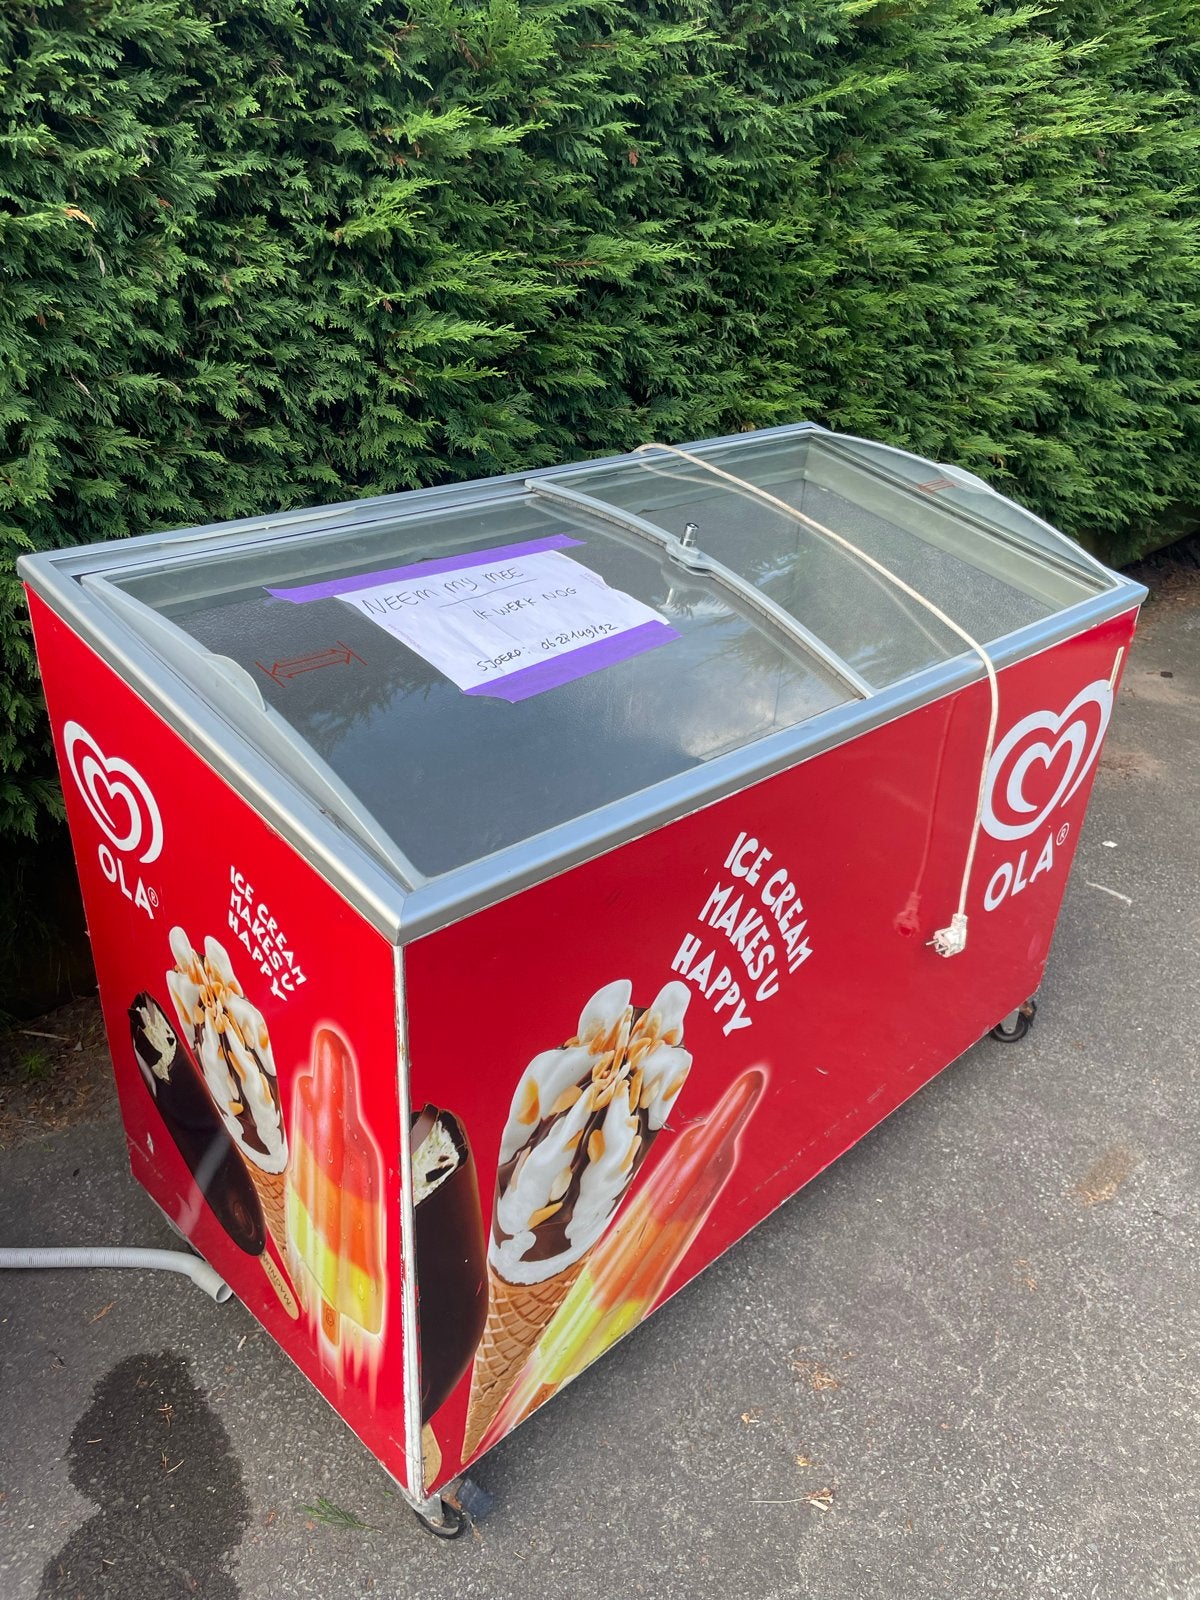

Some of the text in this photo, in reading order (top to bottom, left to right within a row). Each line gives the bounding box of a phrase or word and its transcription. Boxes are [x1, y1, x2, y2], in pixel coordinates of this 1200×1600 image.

[361, 587, 440, 615] NEEM
[482, 566, 524, 584] MEE
[492, 597, 537, 616] WERK
[542, 586, 577, 600] NOG
[230, 865, 307, 986] ICE CREAM
[230, 889, 295, 991] MAKES U
[697, 881, 779, 1001] MAKES U
[723, 831, 813, 974] ICE CREAM
[228, 910, 288, 1001] HAPPY
[670, 932, 752, 1037] HAPPY
